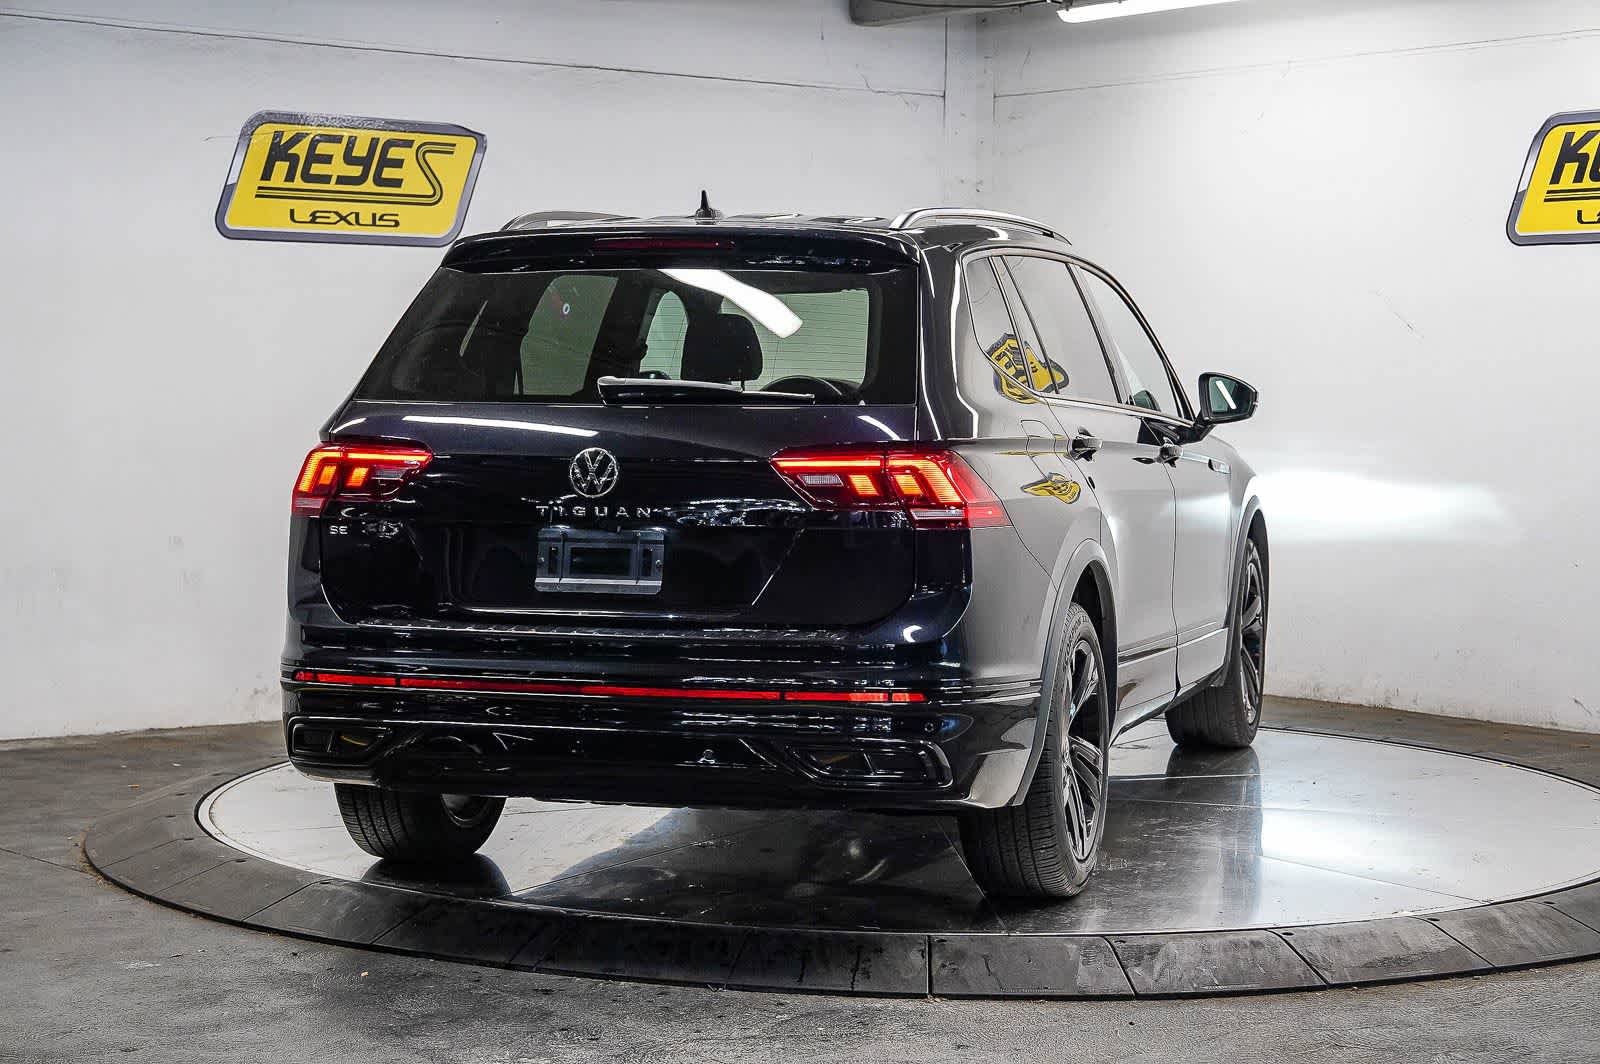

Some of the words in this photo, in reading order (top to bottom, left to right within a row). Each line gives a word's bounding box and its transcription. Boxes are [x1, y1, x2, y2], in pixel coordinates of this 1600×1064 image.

[258, 130, 456, 205] KEYES
[290, 208, 400, 227] LEXUS
[536, 506, 650, 517] TIGUAN
[329, 525, 348, 535] SE
